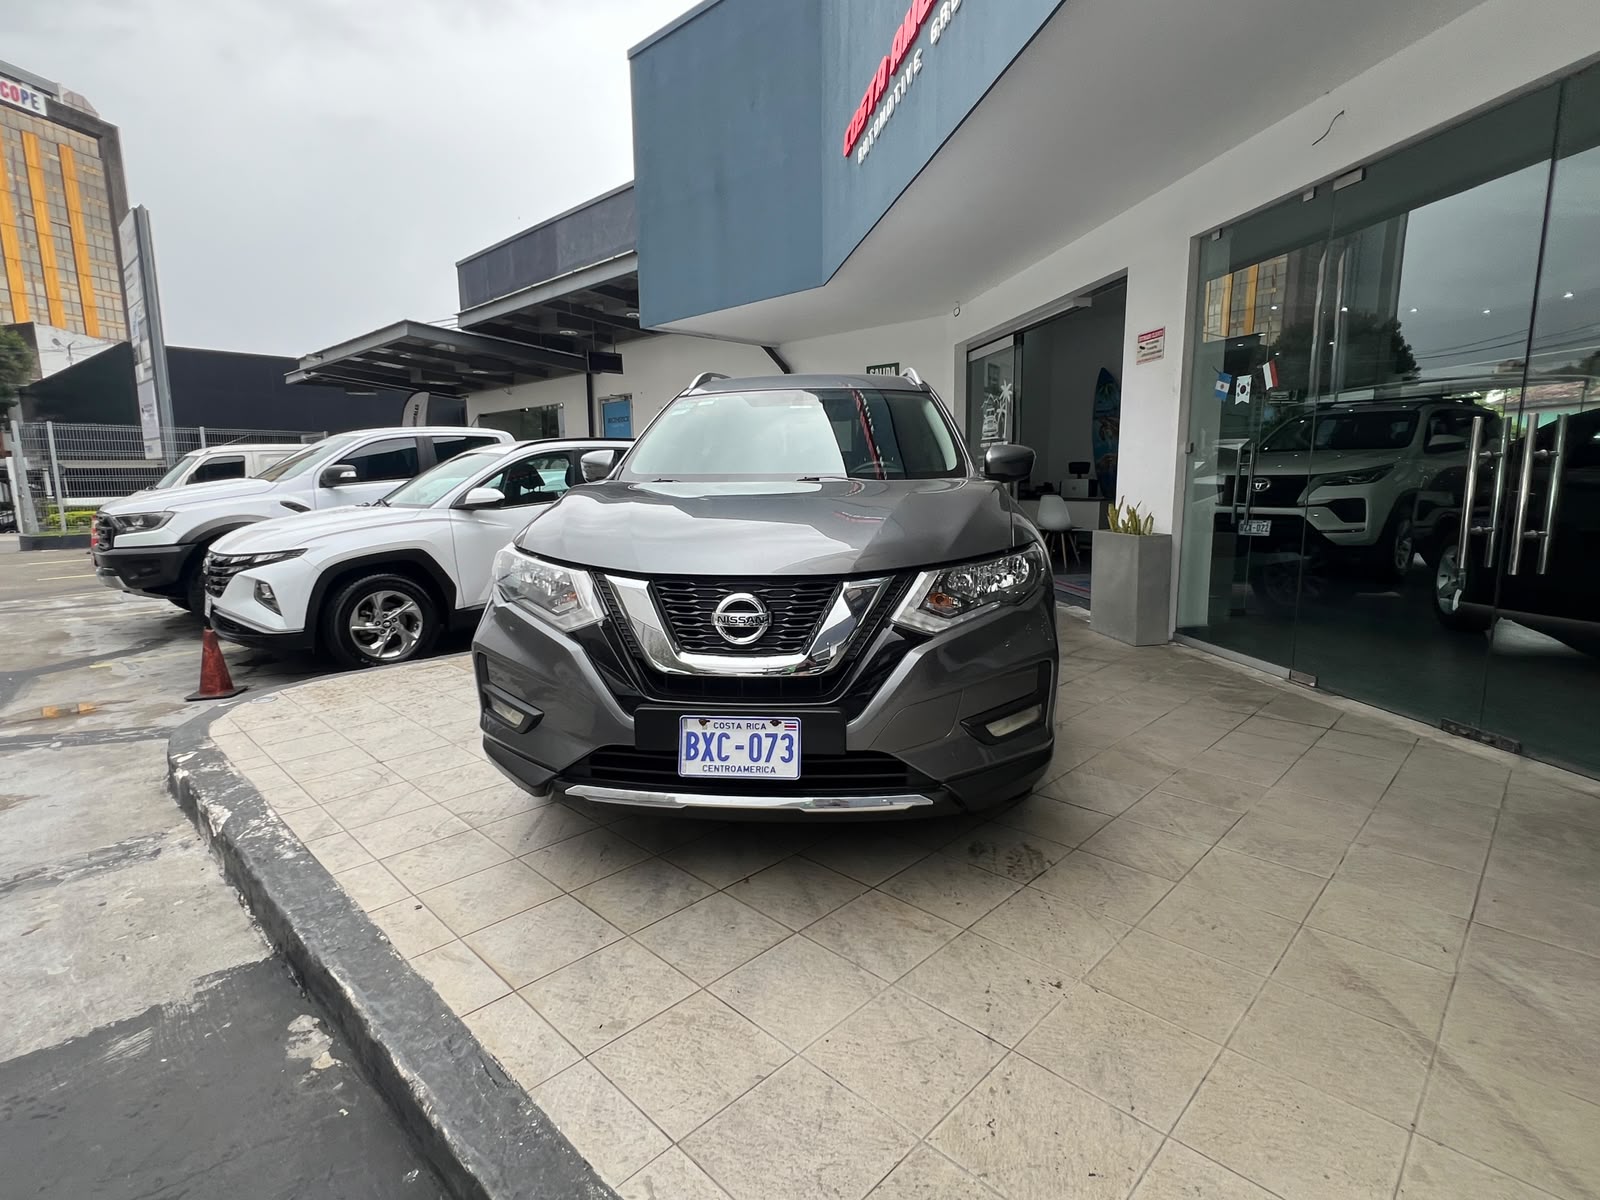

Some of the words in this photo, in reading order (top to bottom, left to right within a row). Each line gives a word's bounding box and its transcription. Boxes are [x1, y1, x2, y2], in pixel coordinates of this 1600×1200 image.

[0, 81, 40, 111] COPE
[843, 55, 890, 157] COSTA
[857, 48, 923, 165] AUTOMOTIVE
[717, 615, 766, 625] NISSAN
[713, 721, 742, 730] COSTA
[746, 722, 767, 730] RICA
[685, 731, 794, 763] BXC-073
[702, 764, 776, 774] CENTROAMERICA
